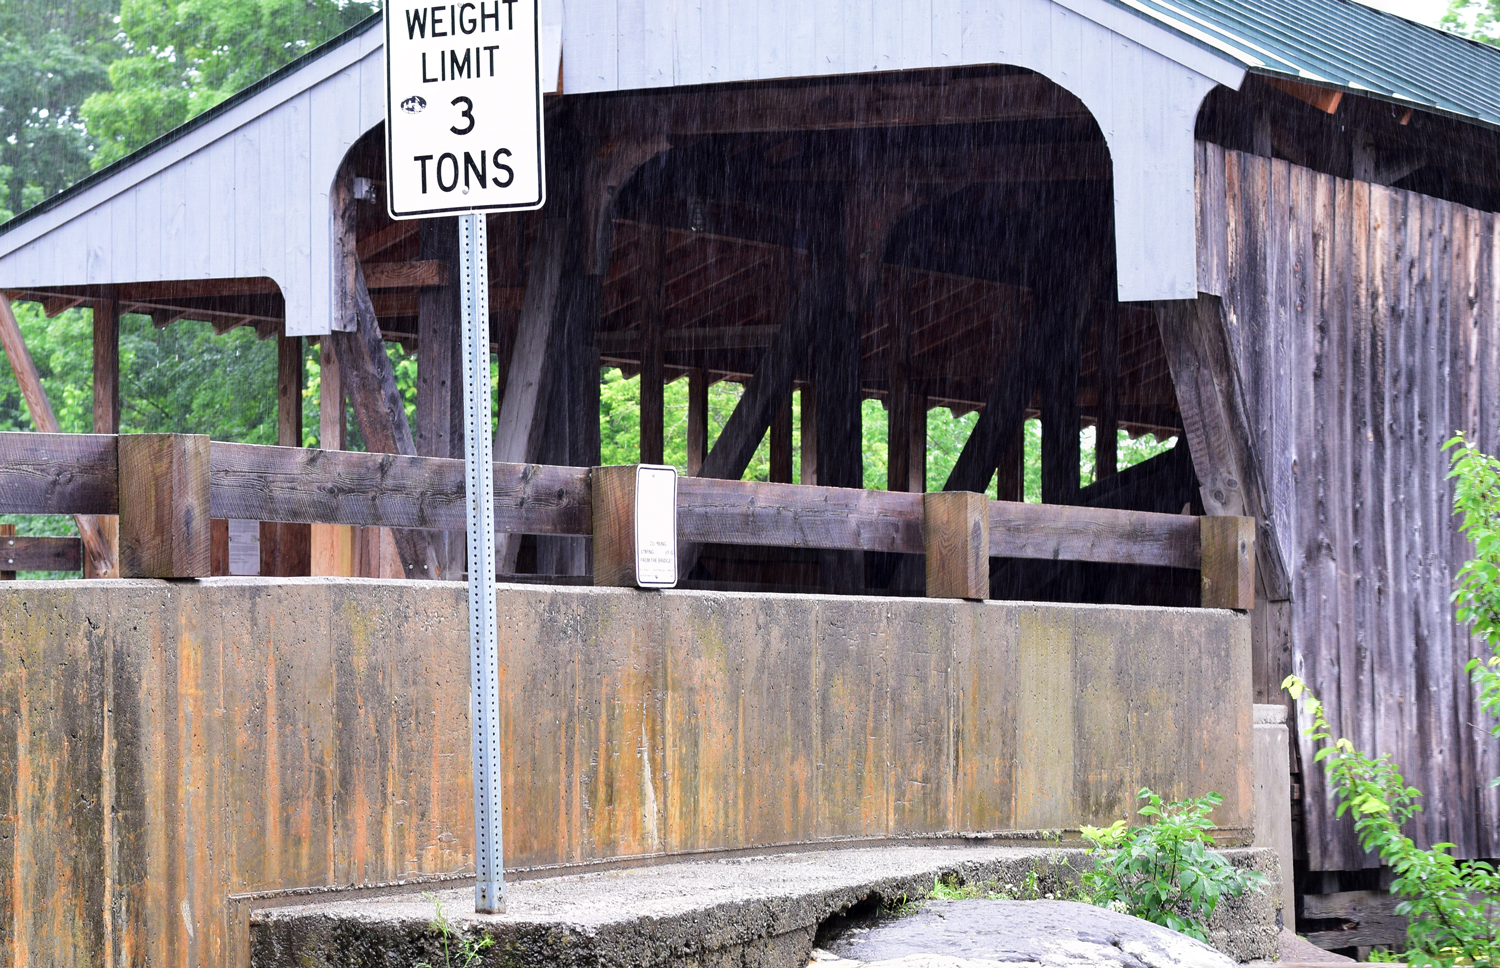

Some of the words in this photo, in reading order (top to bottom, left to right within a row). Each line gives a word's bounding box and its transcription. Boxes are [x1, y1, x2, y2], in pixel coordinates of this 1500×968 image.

[405, 0, 519, 40] WEIGHT
[422, 45, 500, 83] LIMIT
[449, 96, 475, 135] 3
[413, 148, 515, 194] TONS
